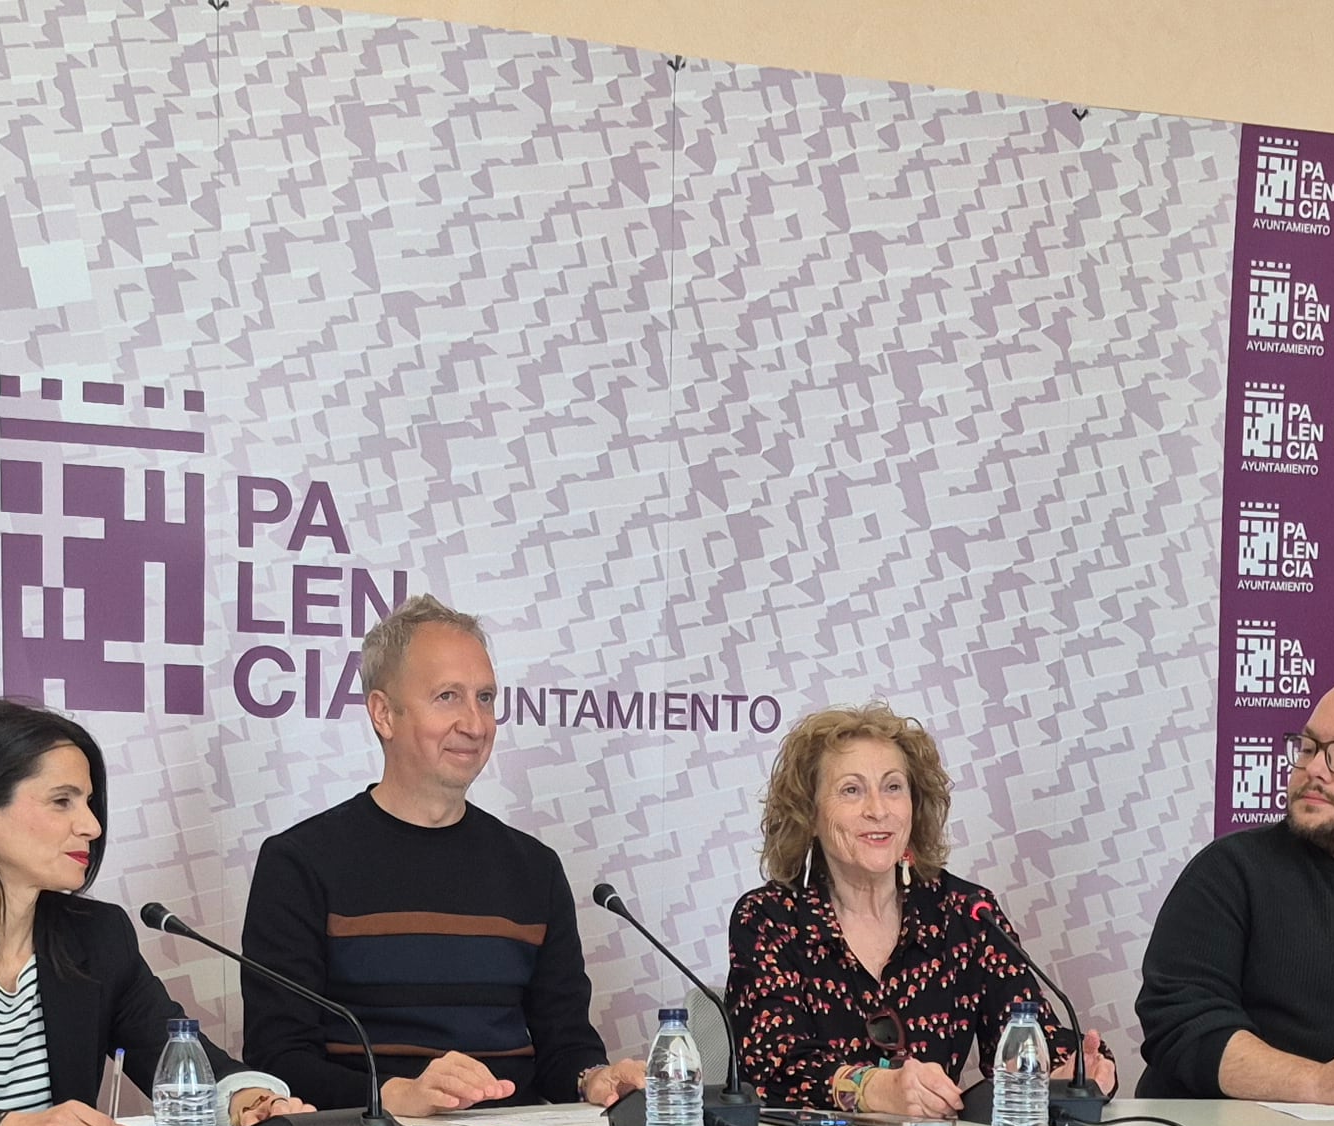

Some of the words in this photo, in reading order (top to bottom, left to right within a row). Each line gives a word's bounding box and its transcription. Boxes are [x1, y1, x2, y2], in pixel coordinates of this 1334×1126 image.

[1301, 160, 1325, 180] PA
[1298, 202, 1331, 221] CIA
[1252, 219, 1330, 235] AYUNTAMIENTO
[1295, 283, 1318, 301] PA
[1293, 302, 1330, 322] LEN
[1292, 322, 1324, 341] CIA
[1246, 341, 1324, 356] AYUNTAMIENTO
[1288, 403, 1312, 421] PA
[1287, 422, 1323, 442] LEN
[1286, 442, 1318, 460] CIA
[1241, 461, 1318, 475] AYUNTAMIENTO
[238, 476, 350, 554] PA
[1283, 522, 1307, 540] PA
[1283, 541, 1318, 559] LEN
[1281, 559, 1313, 578] CIA
[1238, 580, 1313, 592] AYUNTAMIENTO
[237, 561, 407, 638] LEN
[1280, 640, 1303, 656] PA
[1279, 658, 1314, 676] LEN
[1279, 677, 1310, 694] CIA
[496, 687, 782, 734] UNTAMIENTO
[1234, 698, 1310, 708] AYUNTAMIENTO
[1232, 813, 1287, 823] AYUNTAMIE
